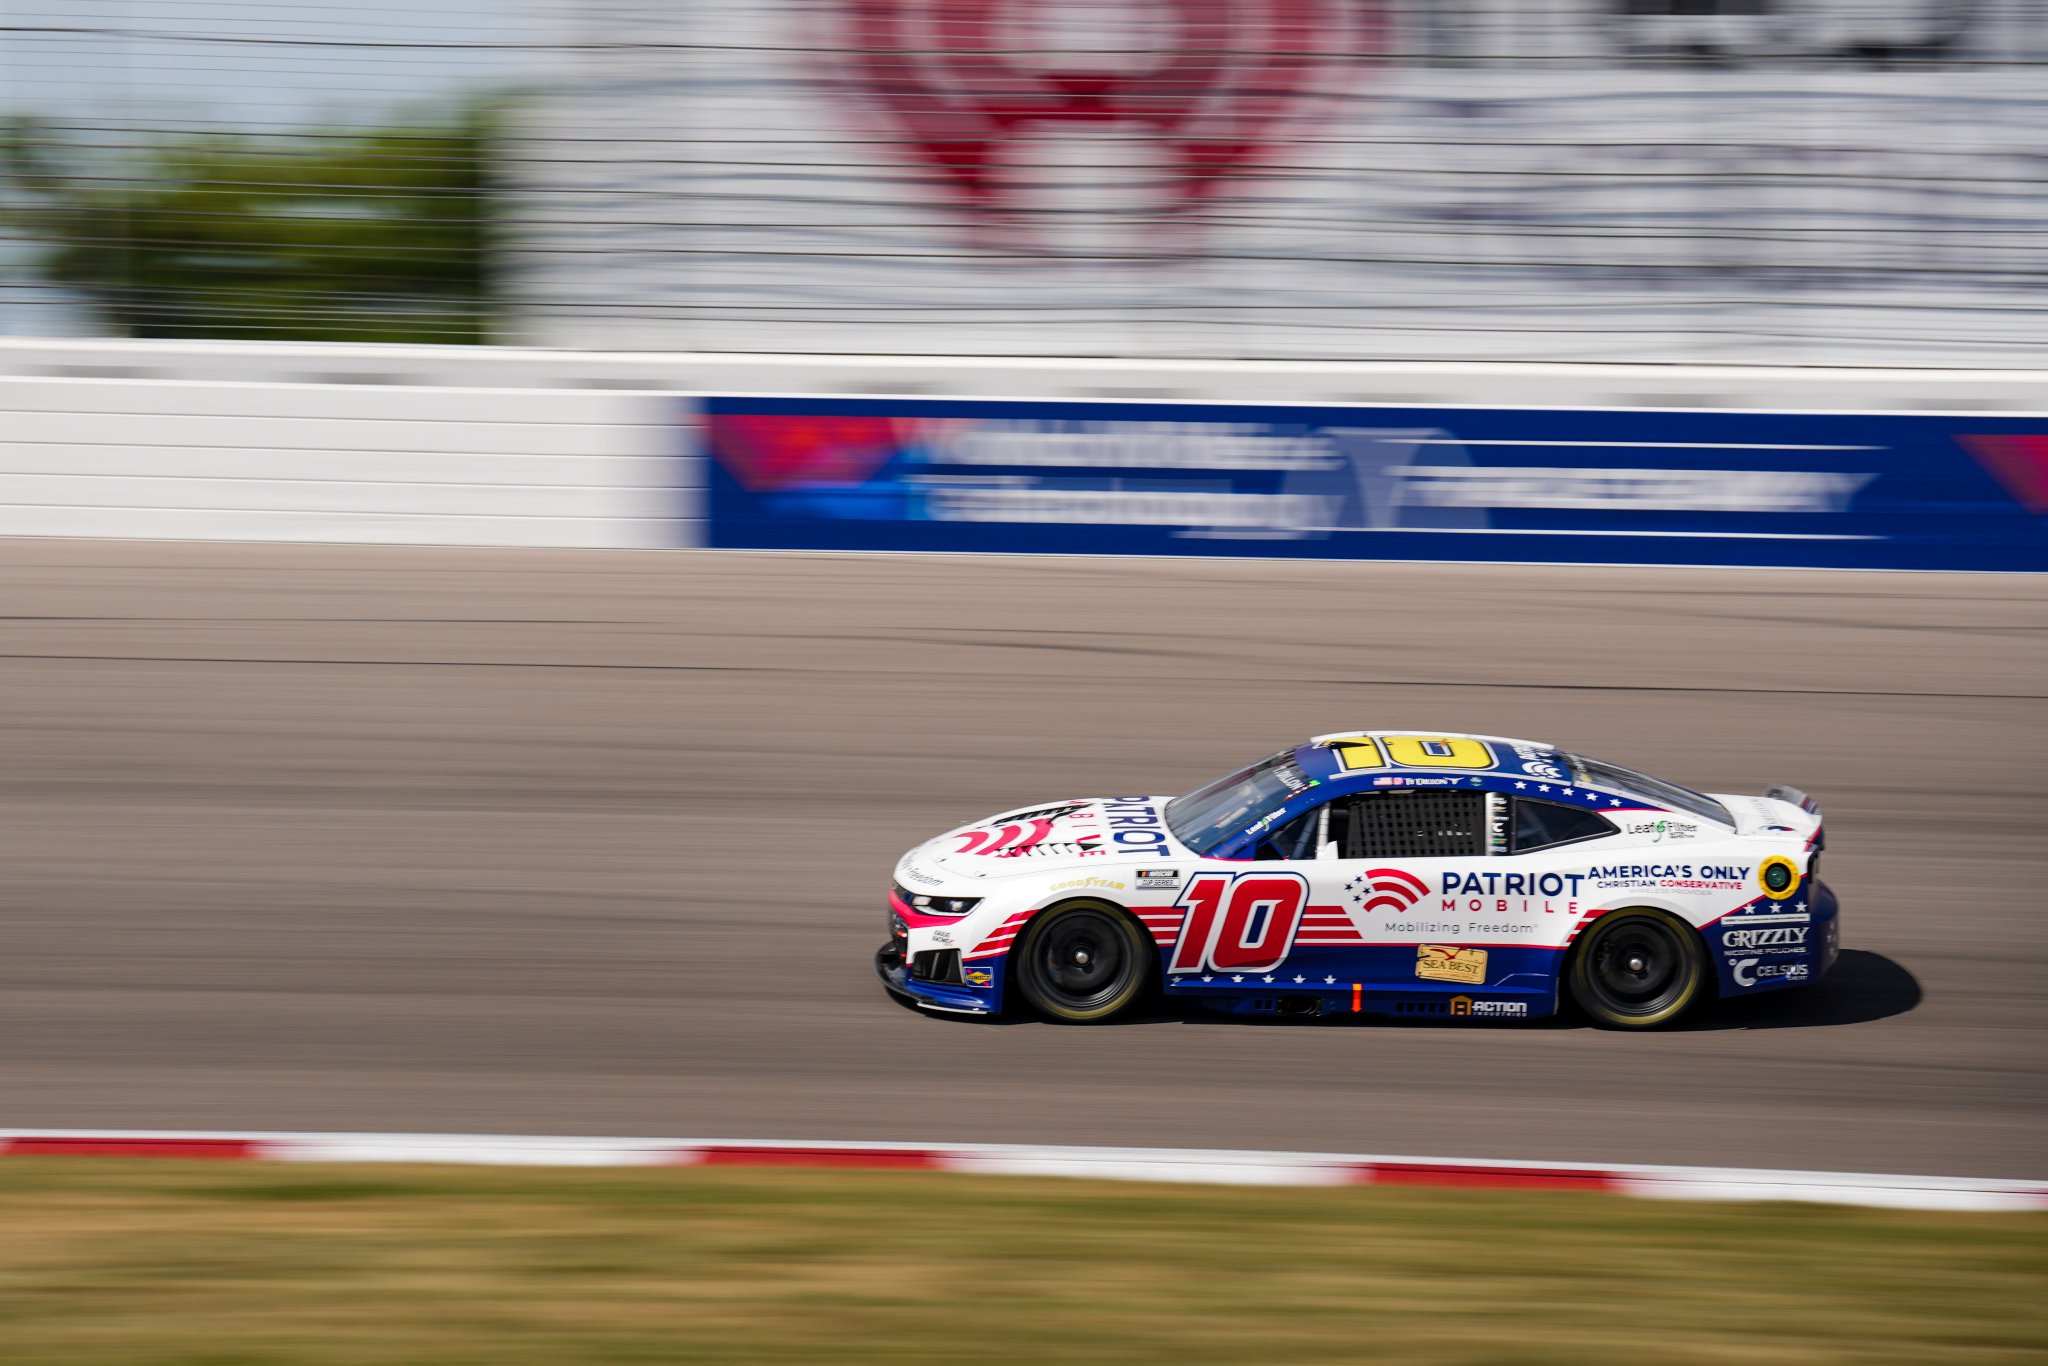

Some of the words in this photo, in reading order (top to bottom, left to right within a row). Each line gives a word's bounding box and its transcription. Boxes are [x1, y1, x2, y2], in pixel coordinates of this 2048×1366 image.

[1312, 733, 1500, 772] 10
[1588, 864, 1692, 880] AMERICA'S
[1700, 865, 1750, 880] ONLY
[1050, 876, 1126, 892] GOODYEAR
[1442, 871, 1585, 898] PATRIOT
[1596, 880, 1656, 889] CHRISTIAN
[1659, 879, 1743, 890] CONSERVATIVE
[1441, 899, 1578, 914] MOBILE
[1166, 871, 1310, 974] 10
[1384, 922, 1460, 934] Mobilizing
[1722, 927, 1810, 949] GRIZZLY
[1422, 959, 1445, 970] SEA
[1449, 962, 1479, 974] BEST
[1756, 964, 1809, 977] CELSIUS
[1473, 1001, 1528, 1012] ACTION
